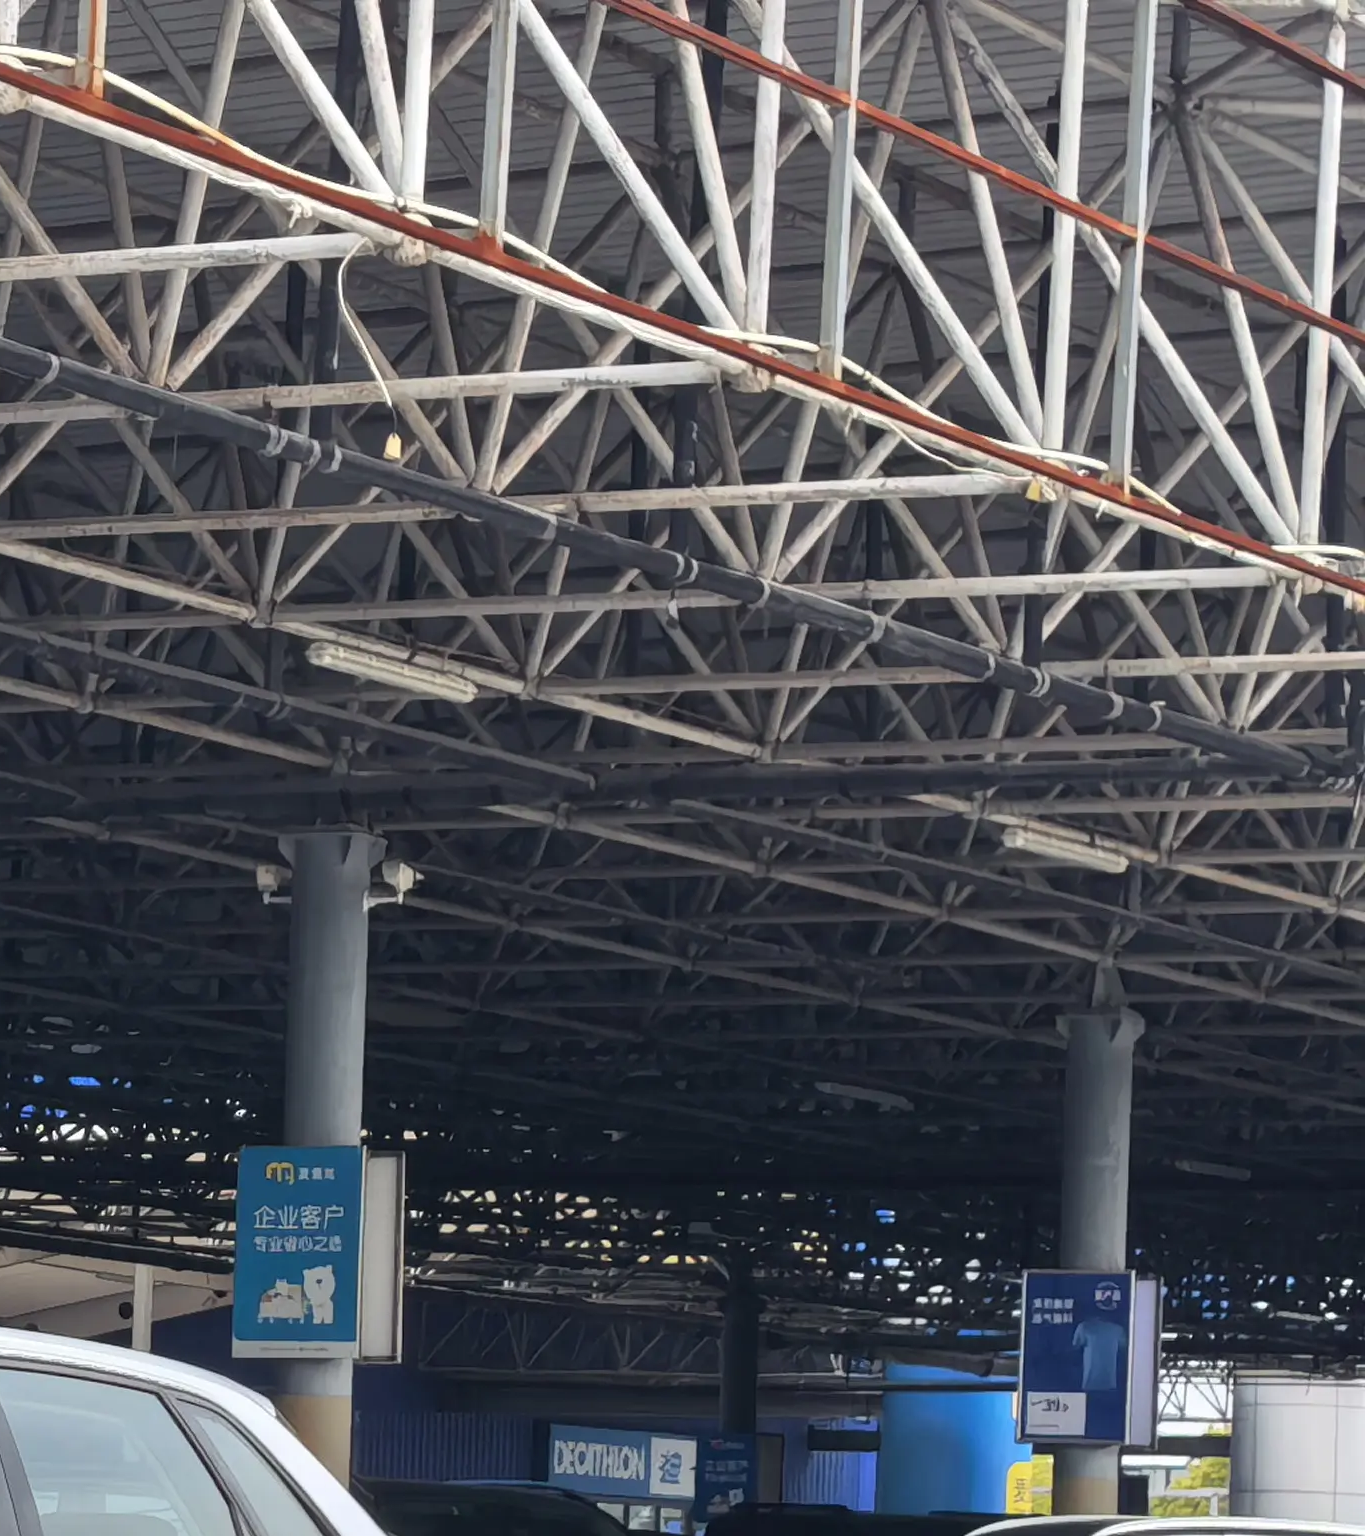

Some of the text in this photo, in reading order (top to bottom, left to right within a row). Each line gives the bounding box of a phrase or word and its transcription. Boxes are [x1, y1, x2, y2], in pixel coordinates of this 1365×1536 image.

[253, 1204, 344, 1231] 企业客户
[553, 1438, 645, 1481] DECATHLON
